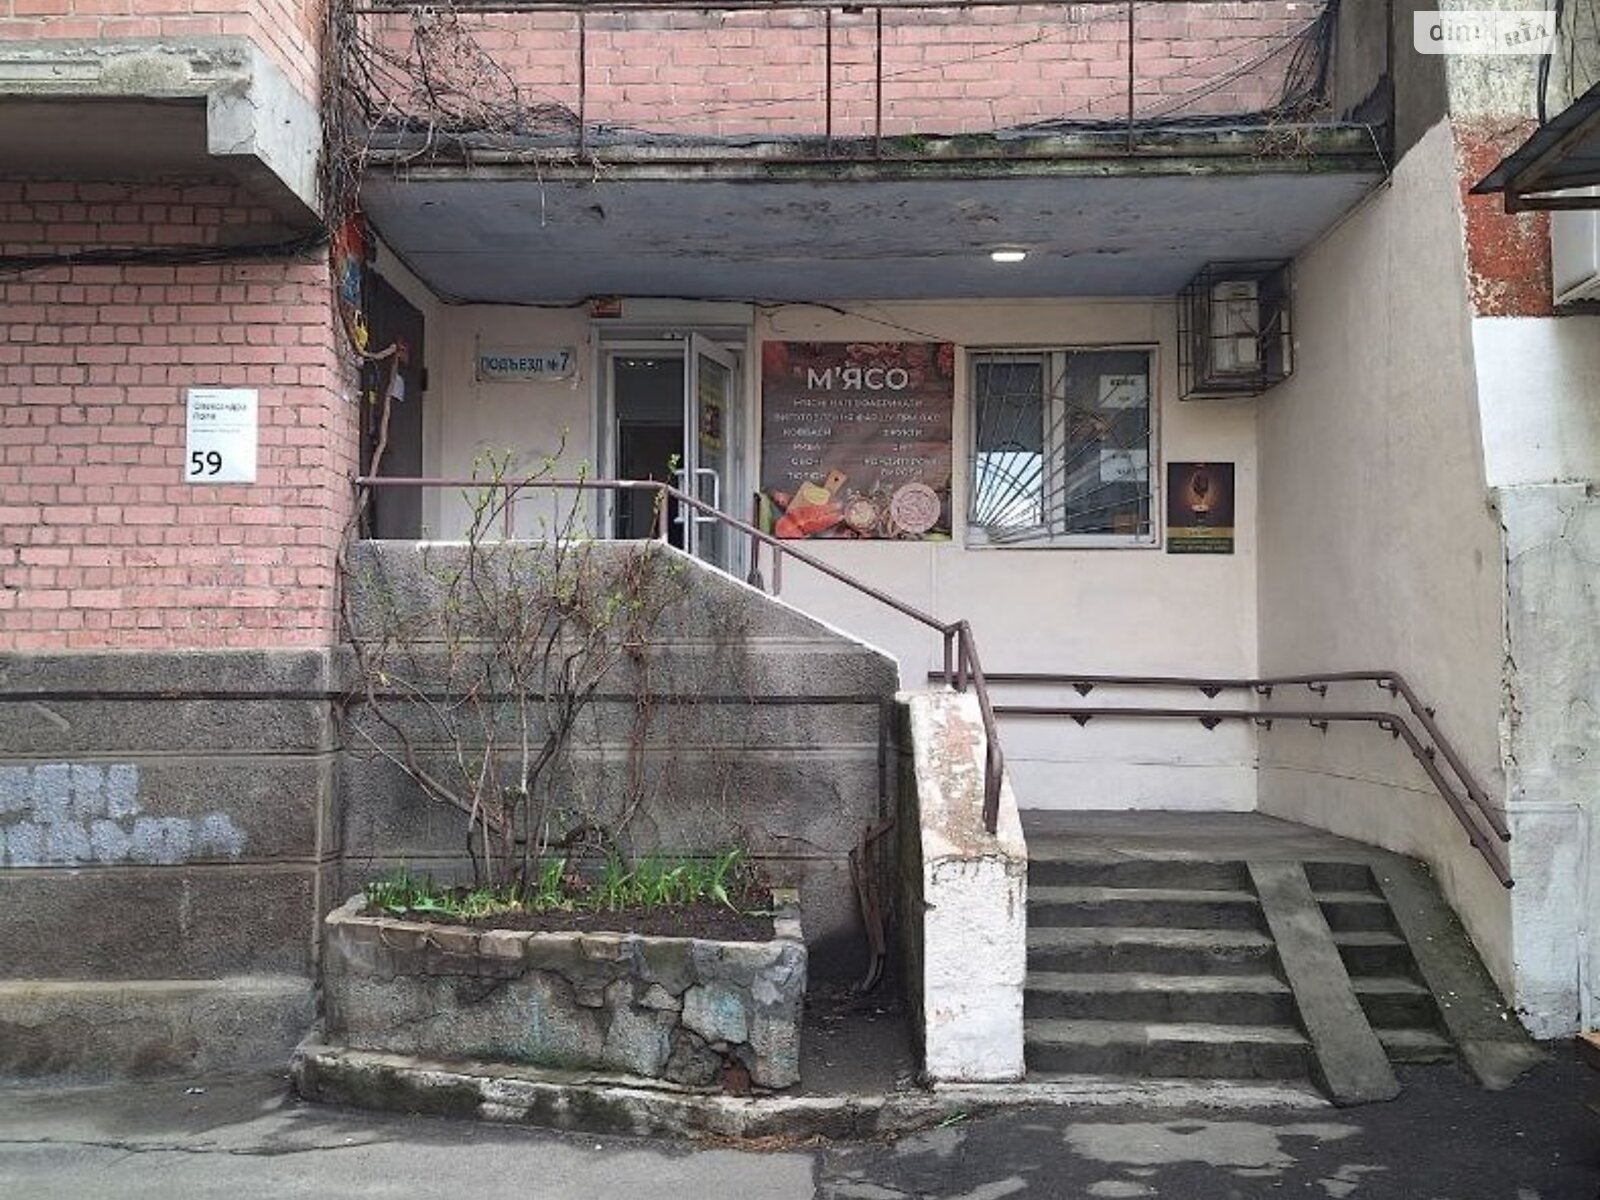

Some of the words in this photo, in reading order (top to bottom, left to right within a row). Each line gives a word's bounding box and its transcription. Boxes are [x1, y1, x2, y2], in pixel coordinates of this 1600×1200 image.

[481, 357, 543, 373] ПОДЪЕЗД
[560, 352, 570, 372] 7
[807, 366, 909, 390] М'ЯСО
[190, 451, 222, 475] 59
